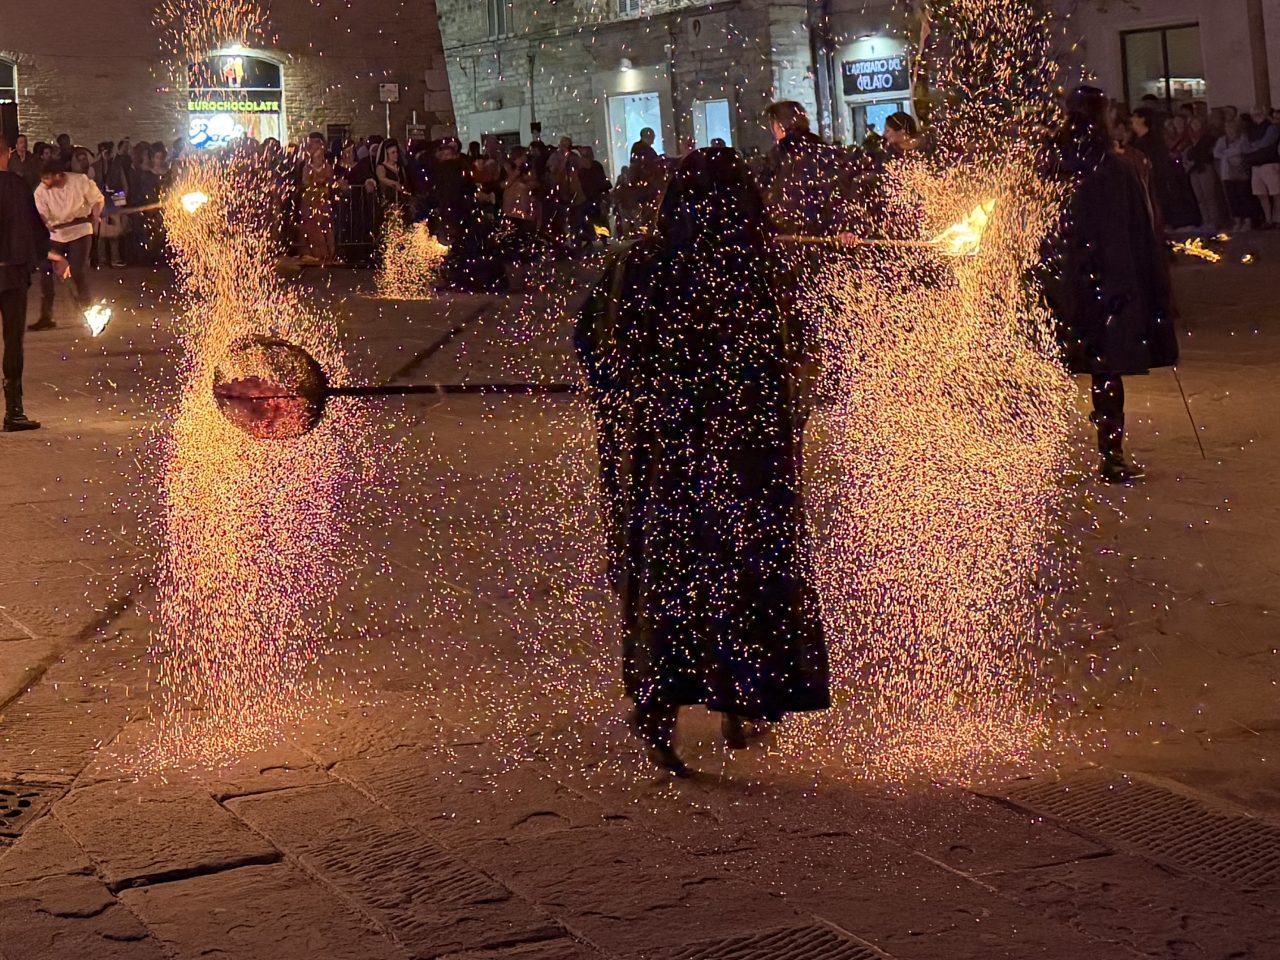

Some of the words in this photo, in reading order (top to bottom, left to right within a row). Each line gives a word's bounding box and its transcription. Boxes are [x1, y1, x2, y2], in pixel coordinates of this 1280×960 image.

[889, 59, 902, 71] DEL
[857, 74, 893, 90] GELATO
[187, 101, 279, 111] EUROCHOCOLATE
